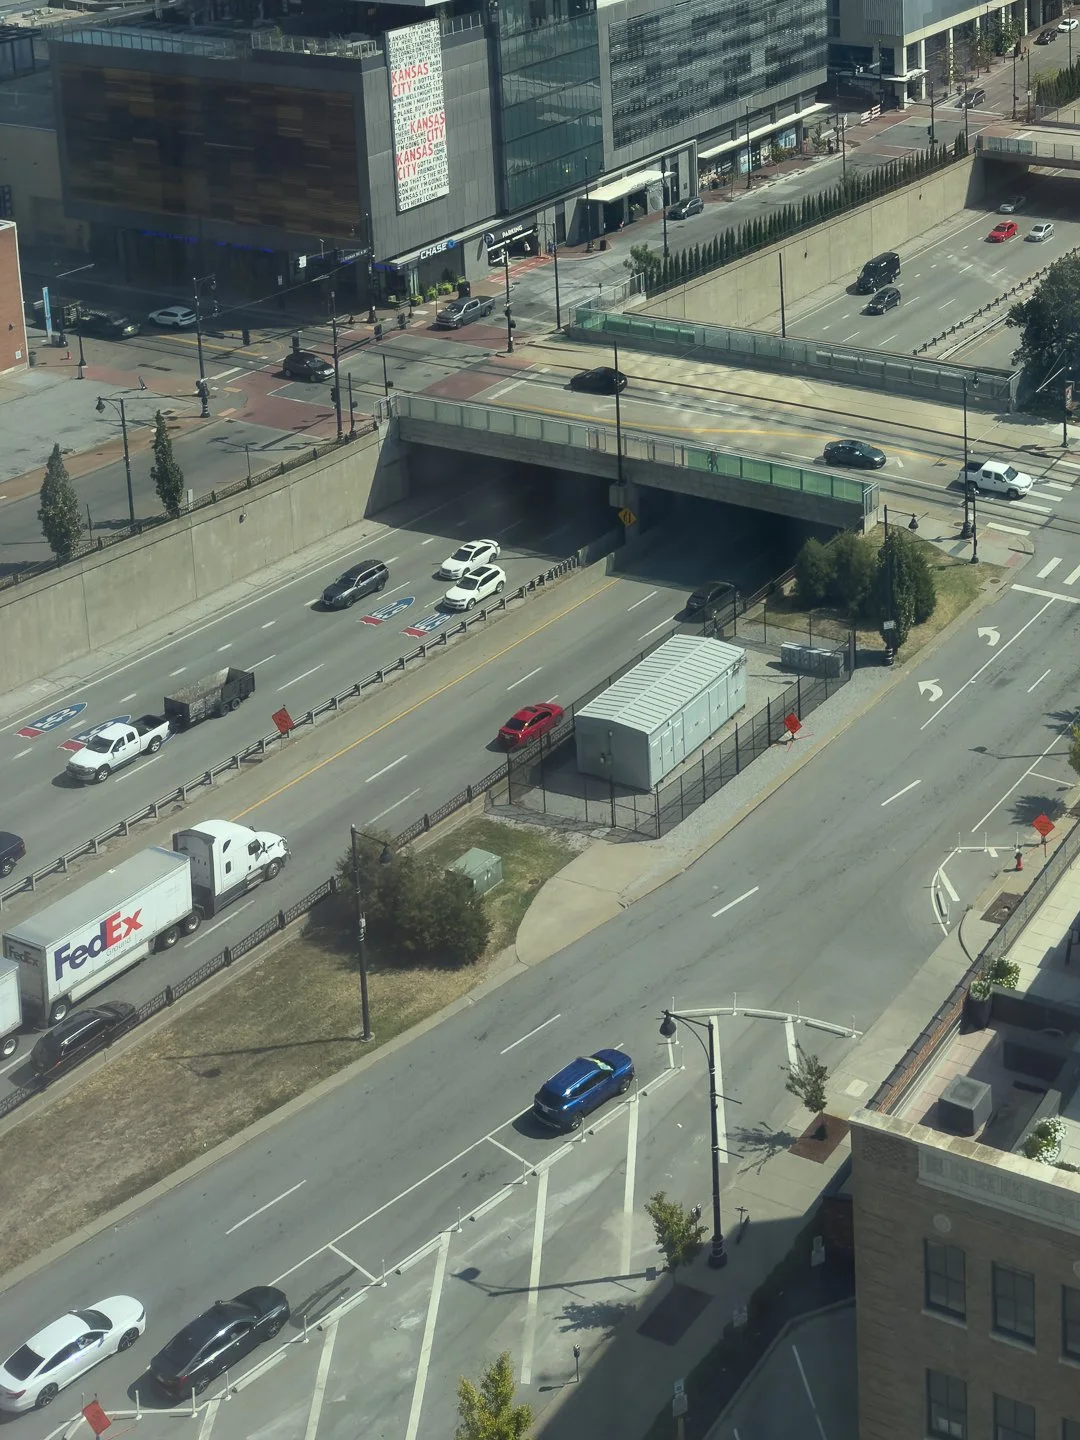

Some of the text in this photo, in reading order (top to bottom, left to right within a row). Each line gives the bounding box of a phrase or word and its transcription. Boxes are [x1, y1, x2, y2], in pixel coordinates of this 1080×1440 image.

[391, 62, 428, 83] KANSAS
[392, 80, 412, 97] CITY
[410, 111, 445, 133] KANSAS
[396, 142, 433, 166] KANSAS
[397, 162, 416, 180] CITY
[502, 225, 523, 238] PARKING
[420, 243, 447, 259] CHASE
[54, 908, 143, 981] FedEx
[106, 934, 137, 957] Ground
[8, 945, 39, 968] FedEx
